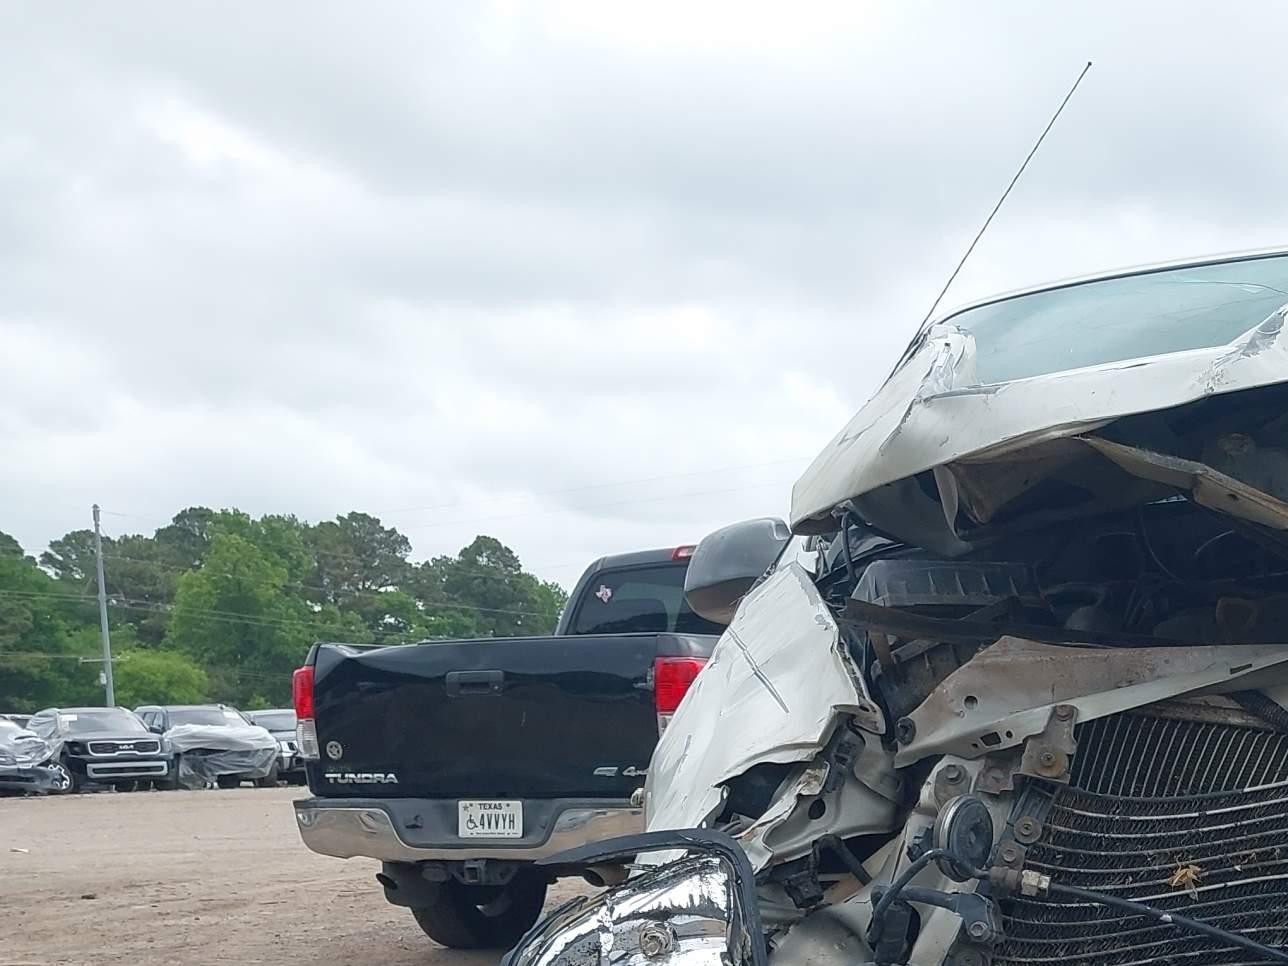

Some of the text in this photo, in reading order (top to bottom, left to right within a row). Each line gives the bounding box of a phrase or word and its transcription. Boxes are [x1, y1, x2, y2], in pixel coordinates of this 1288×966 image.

[324, 772, 399, 784] TUNDRA
[478, 802, 503, 810] TEXAS
[479, 813, 515, 830] 4VVYH
